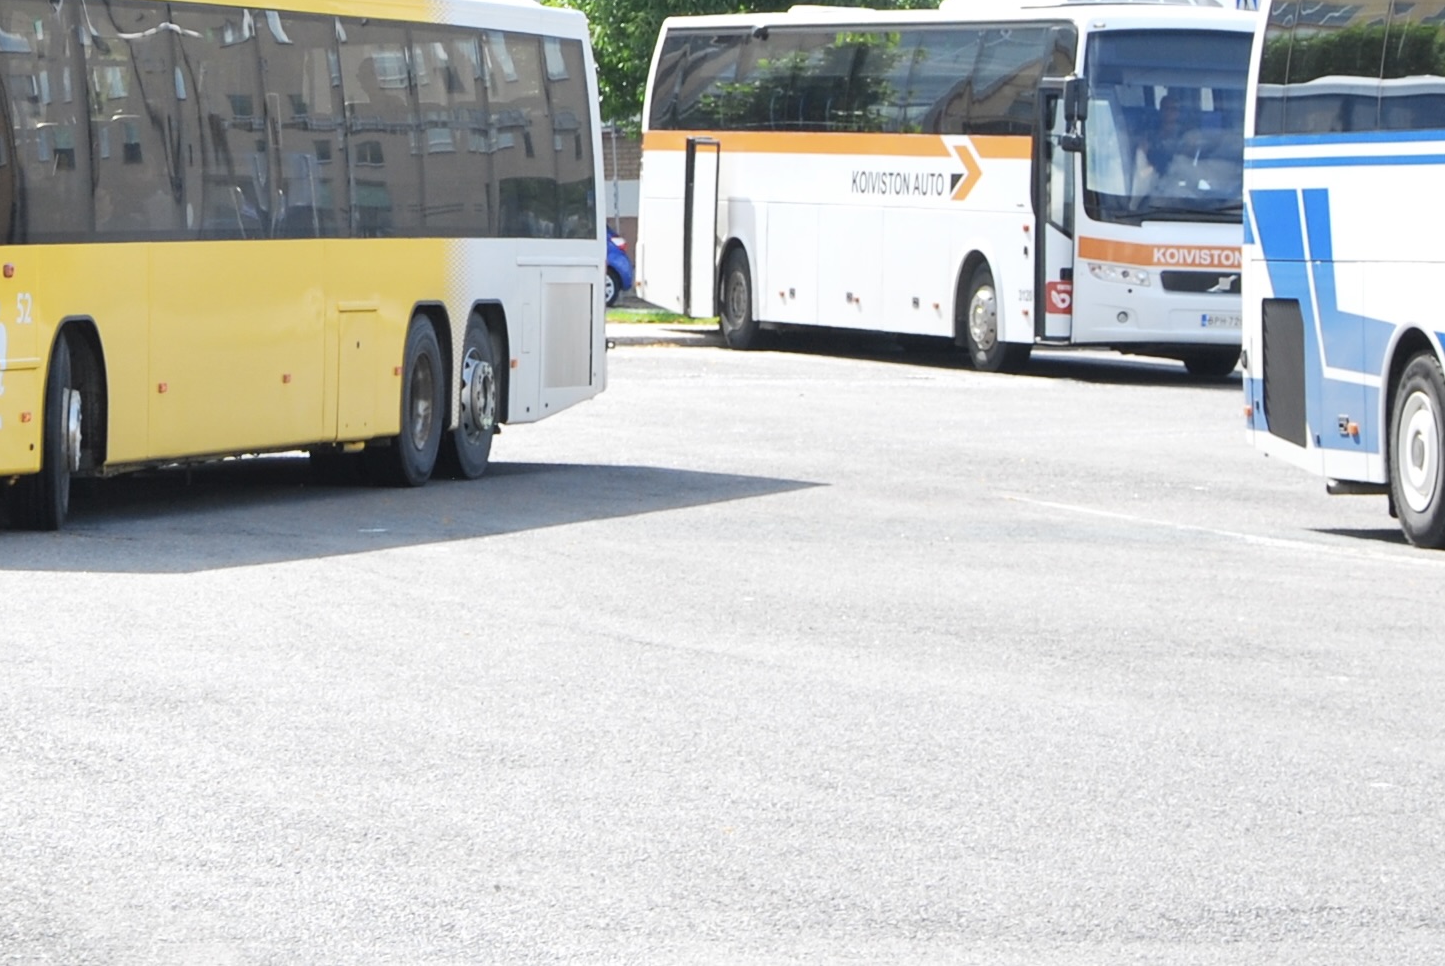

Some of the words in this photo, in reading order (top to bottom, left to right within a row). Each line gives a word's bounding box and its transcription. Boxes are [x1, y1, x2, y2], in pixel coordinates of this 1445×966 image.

[851, 170, 910, 195] KOIVISTON
[912, 172, 945, 196] AUTO
[1153, 247, 1242, 266] KOIVISTON
[16, 292, 33, 324] 52
